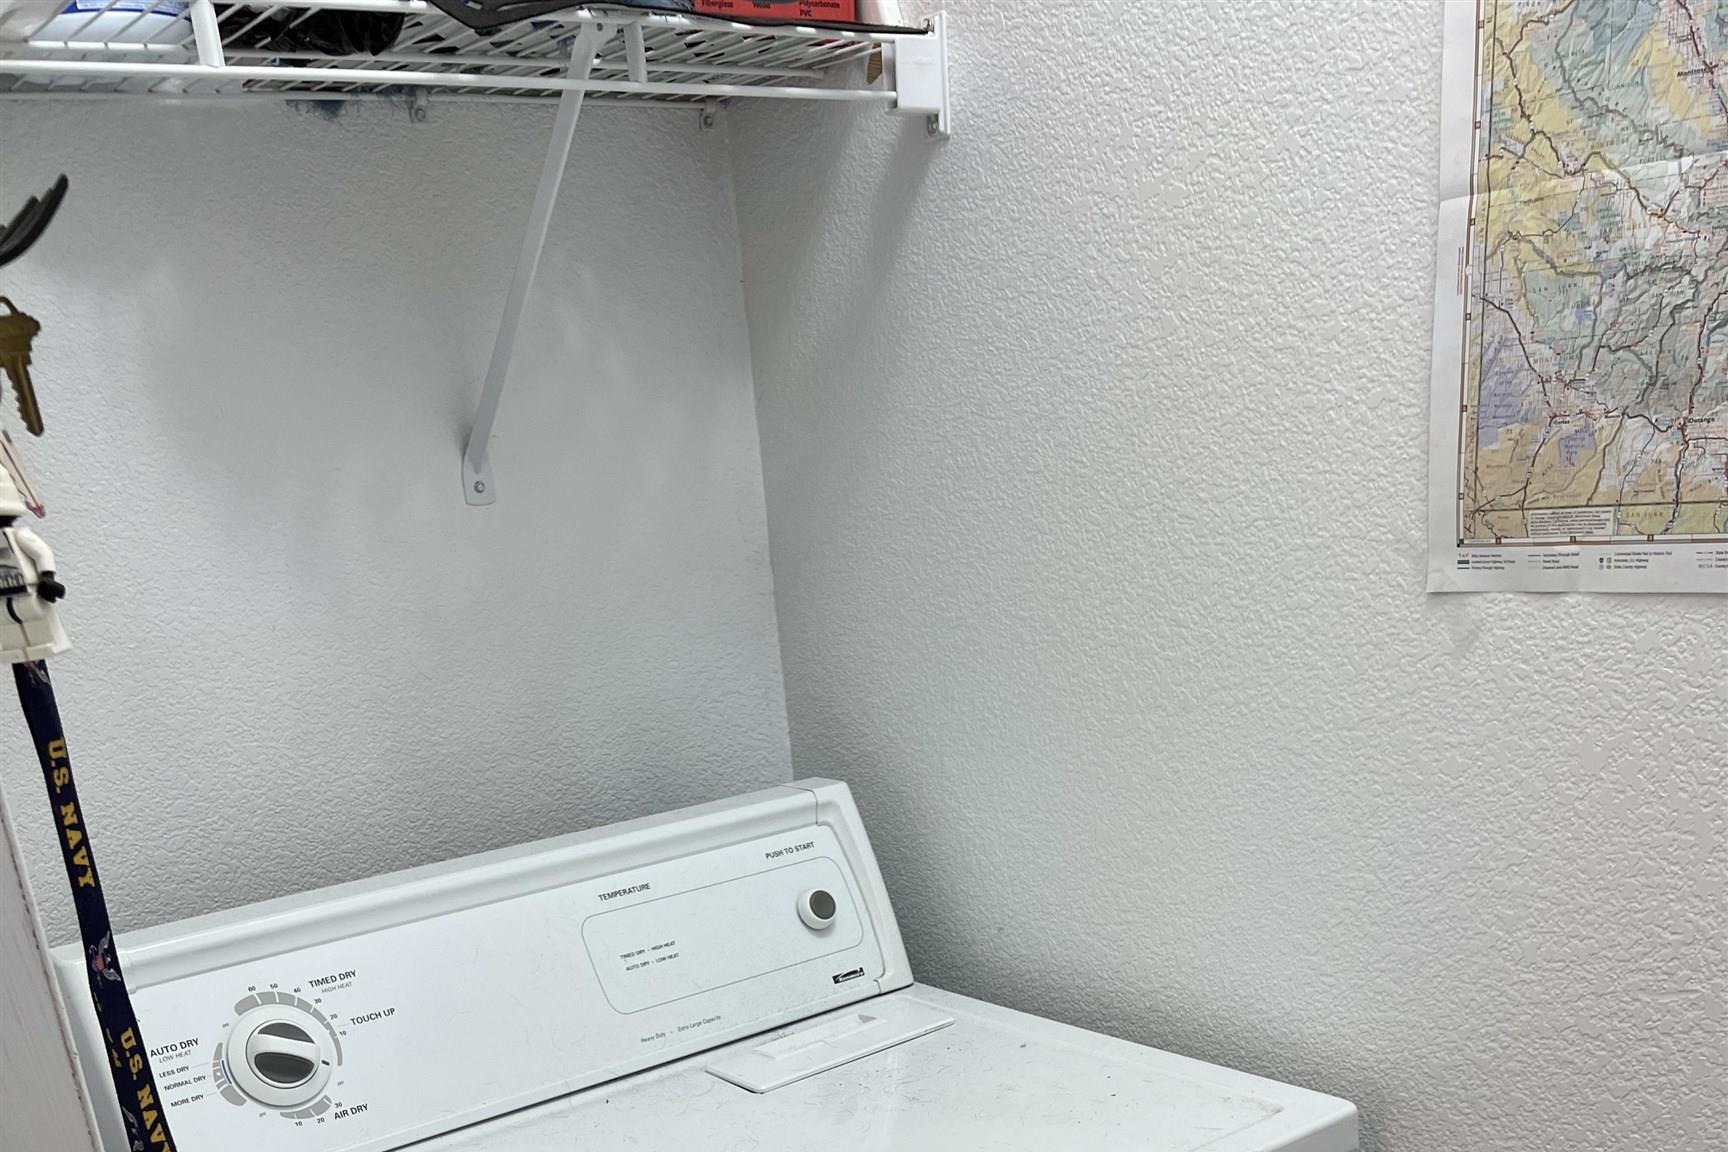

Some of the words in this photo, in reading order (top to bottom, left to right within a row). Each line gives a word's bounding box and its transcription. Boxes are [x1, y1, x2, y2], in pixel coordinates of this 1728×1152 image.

[800, 9, 812, 17] PVC
[48, 737, 70, 794] U.S.
[60, 801, 96, 888] NAVY
[765, 848, 784, 860] PUSH
[784, 845, 795, 855] TO
[795, 841, 815, 852] START
[598, 882, 651, 902] TEMPERATURE
[308, 975, 337, 989] TIMED
[338, 970, 357, 981] DRY
[350, 1012, 382, 1026] TOUCH
[383, 1007, 396, 1017] UP
[120, 1027, 143, 1080] U.S.
[150, 1043, 178, 1058] AUTO
[179, 1037, 199, 1050] DRY
[159, 1054, 174, 1064] LOW
[175, 1049, 191, 1059] HEAT
[159, 1069, 175, 1078] LESS
[176, 1065, 189, 1074] DRY
[164, 1079, 192, 1091] NORMAL
[193, 1074, 206, 1083] DRY
[171, 1097, 190, 1107] MORE
[191, 1093, 204, 1102] DRY
[334, 1109, 350, 1120] AIR
[350, 1103, 369, 1116] DRY
